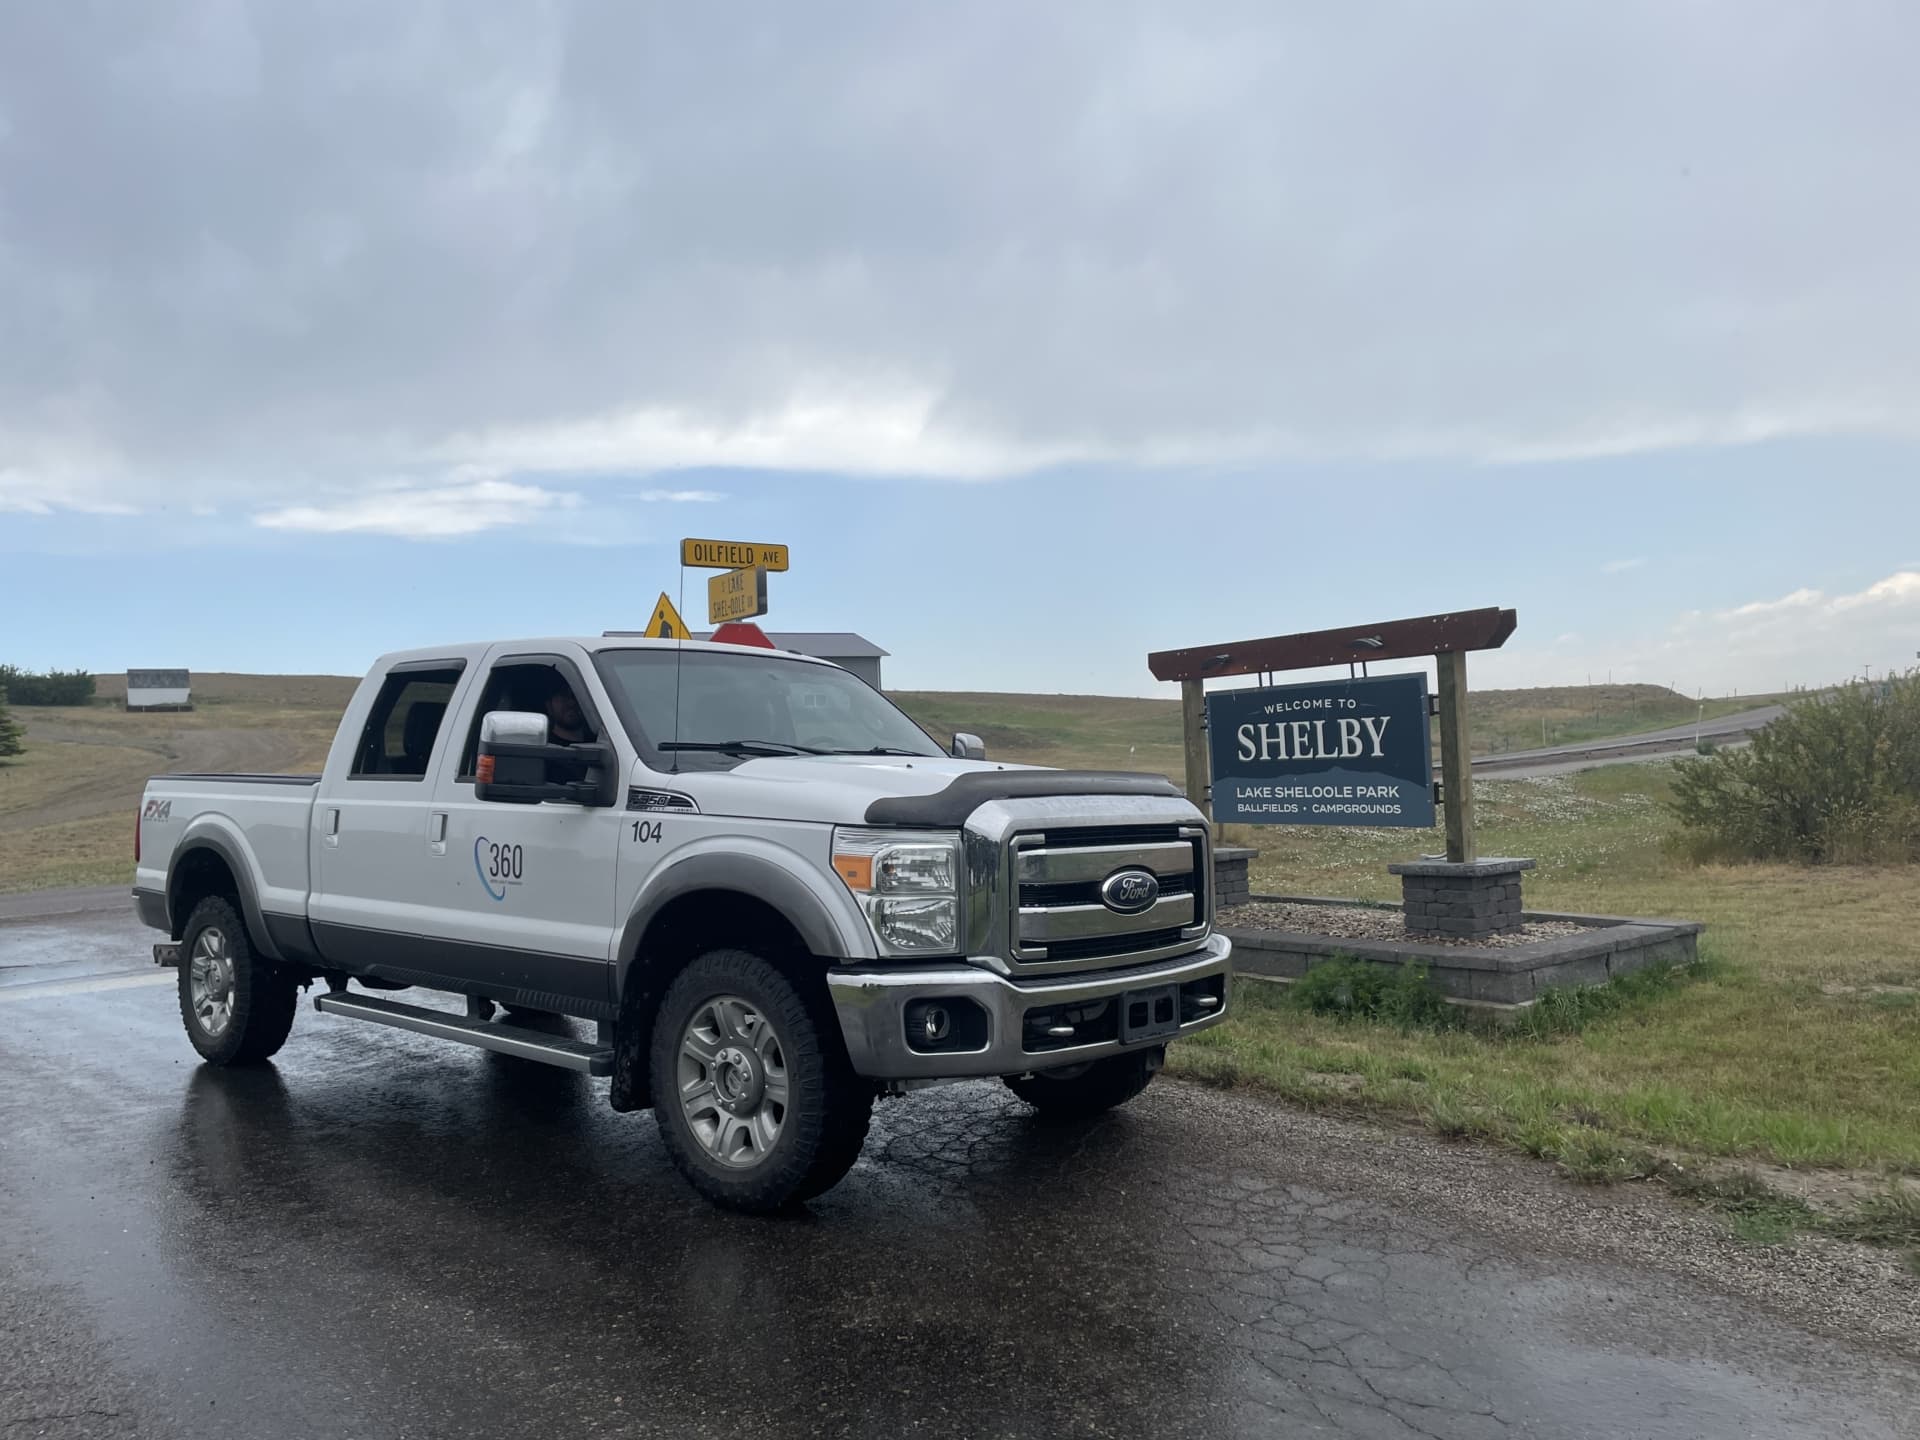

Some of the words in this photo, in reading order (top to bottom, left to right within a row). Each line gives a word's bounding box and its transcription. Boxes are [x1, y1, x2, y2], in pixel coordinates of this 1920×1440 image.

[694, 543, 754, 564] OILFIELD
[763, 551, 779, 563] AVE
[728, 573, 744, 594] LAKE
[1264, 699, 1332, 715] WELCOME
[1338, 699, 1357, 709] TO
[1237, 716, 1391, 761] SHELBY
[1237, 787, 1272, 798] LAKE
[1274, 786, 1353, 798] SHELOOLE
[1357, 785, 1400, 798] PARK
[144, 799, 172, 818] FX4
[1237, 803, 1298, 813] BALLFIELDS
[1312, 803, 1402, 814] CAMPGROUNDS
[631, 821, 662, 844] 104
[489, 843, 523, 879] 360
[1120, 877, 1150, 900] Ford
